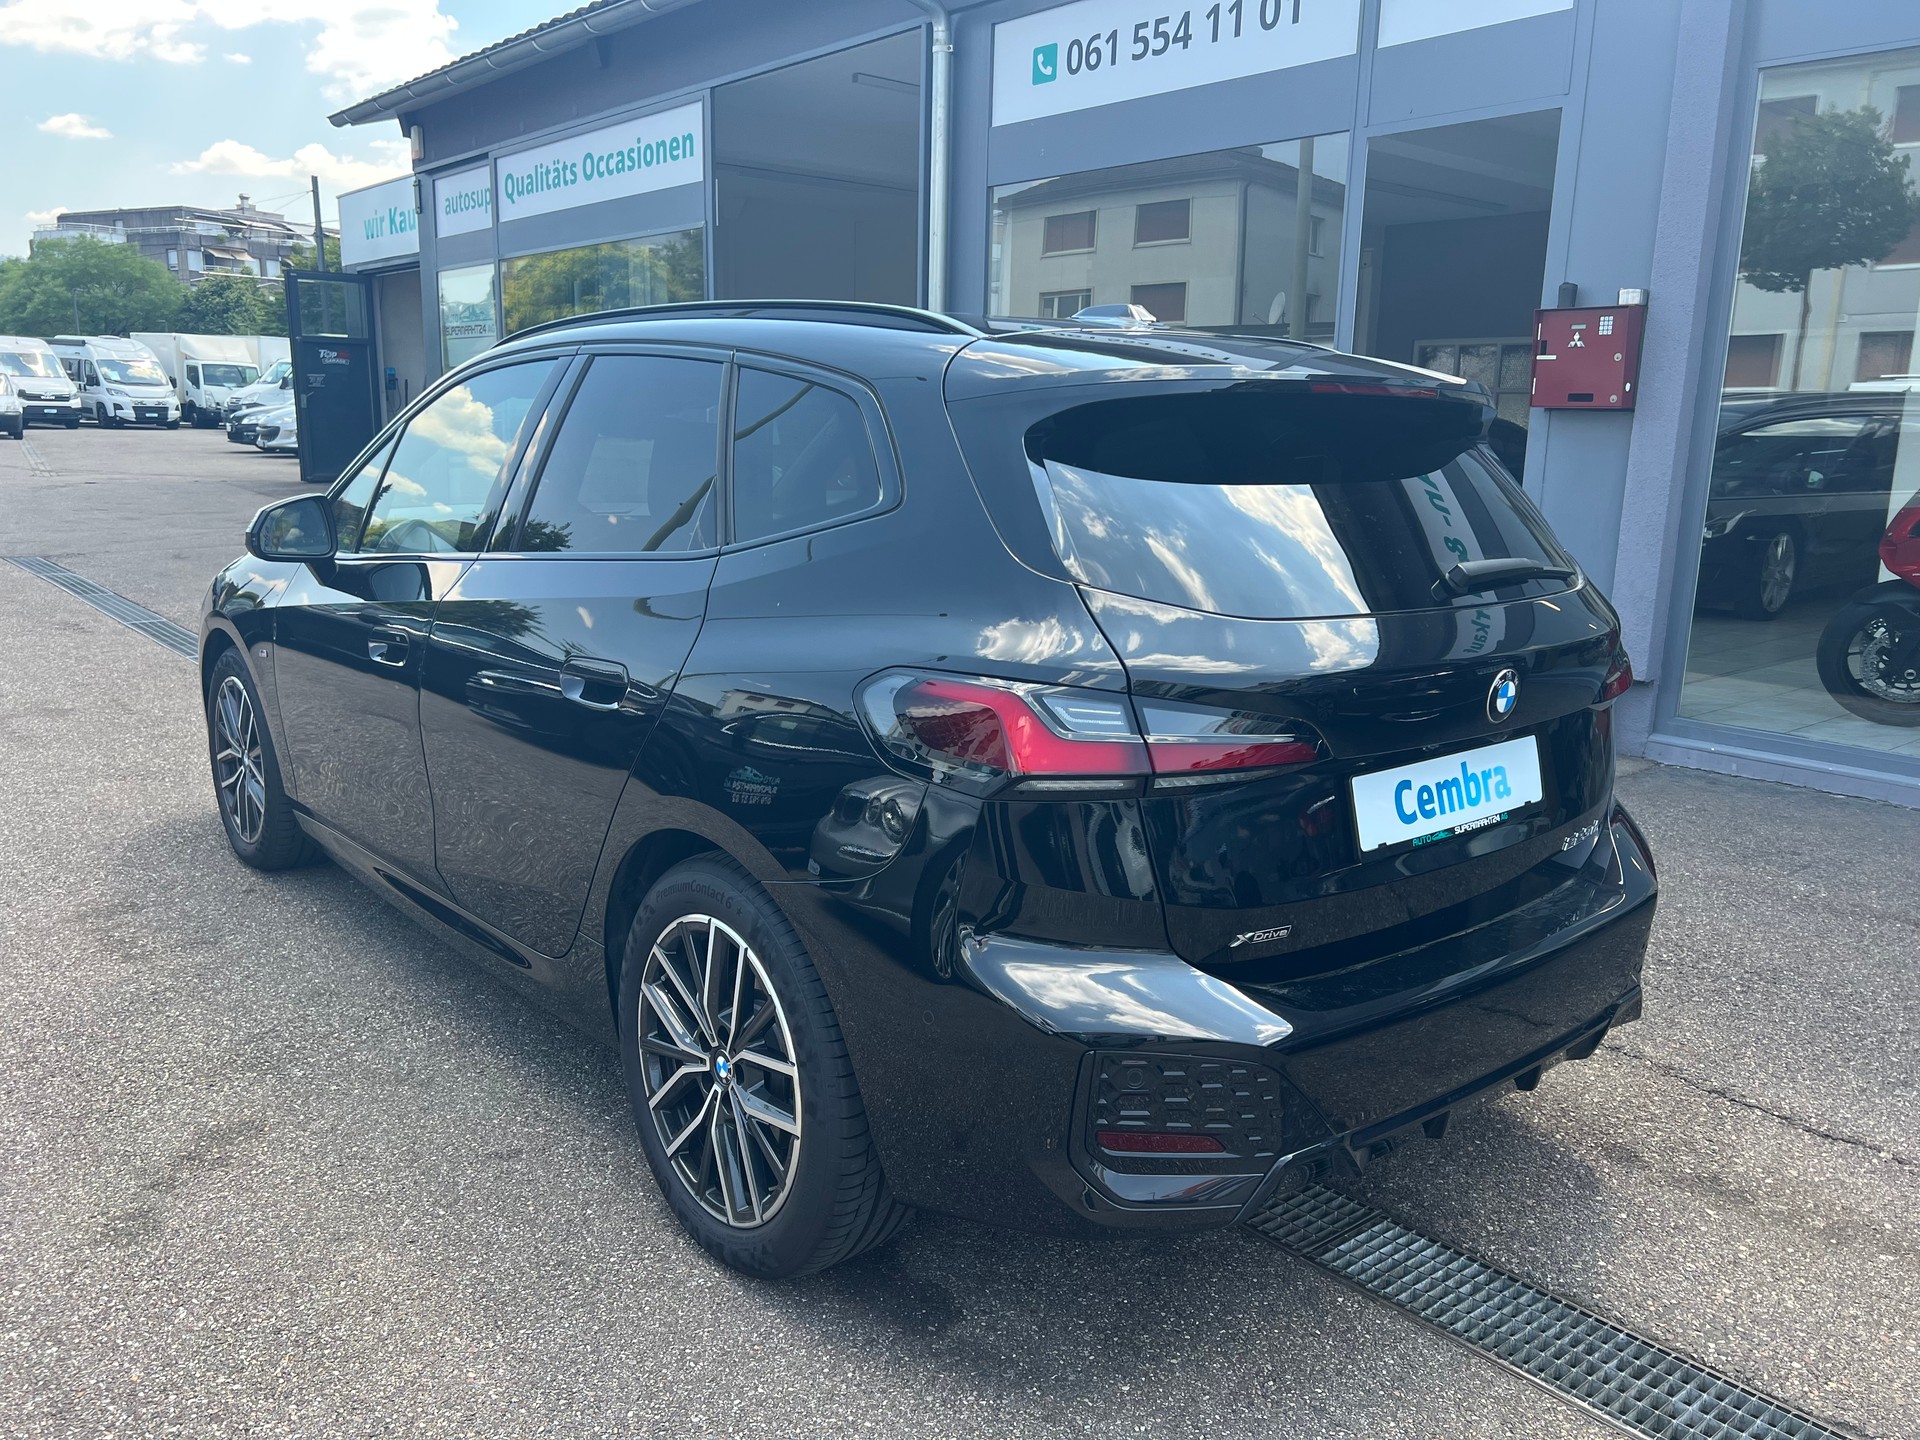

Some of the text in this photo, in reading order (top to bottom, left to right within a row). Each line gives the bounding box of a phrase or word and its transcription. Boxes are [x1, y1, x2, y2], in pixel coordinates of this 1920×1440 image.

[1066, 29, 1118, 76] 061
[1131, 10, 1193, 62] 554
[1205, 0, 1243, 43] 11
[504, 132, 695, 204] Qualitäts Occasionen
[363, 209, 385, 240] wir
[1394, 761, 1512, 825] Cembra
[1412, 834, 1432, 847] AUTO
[655, 879, 734, 910] PremiumContact 6
